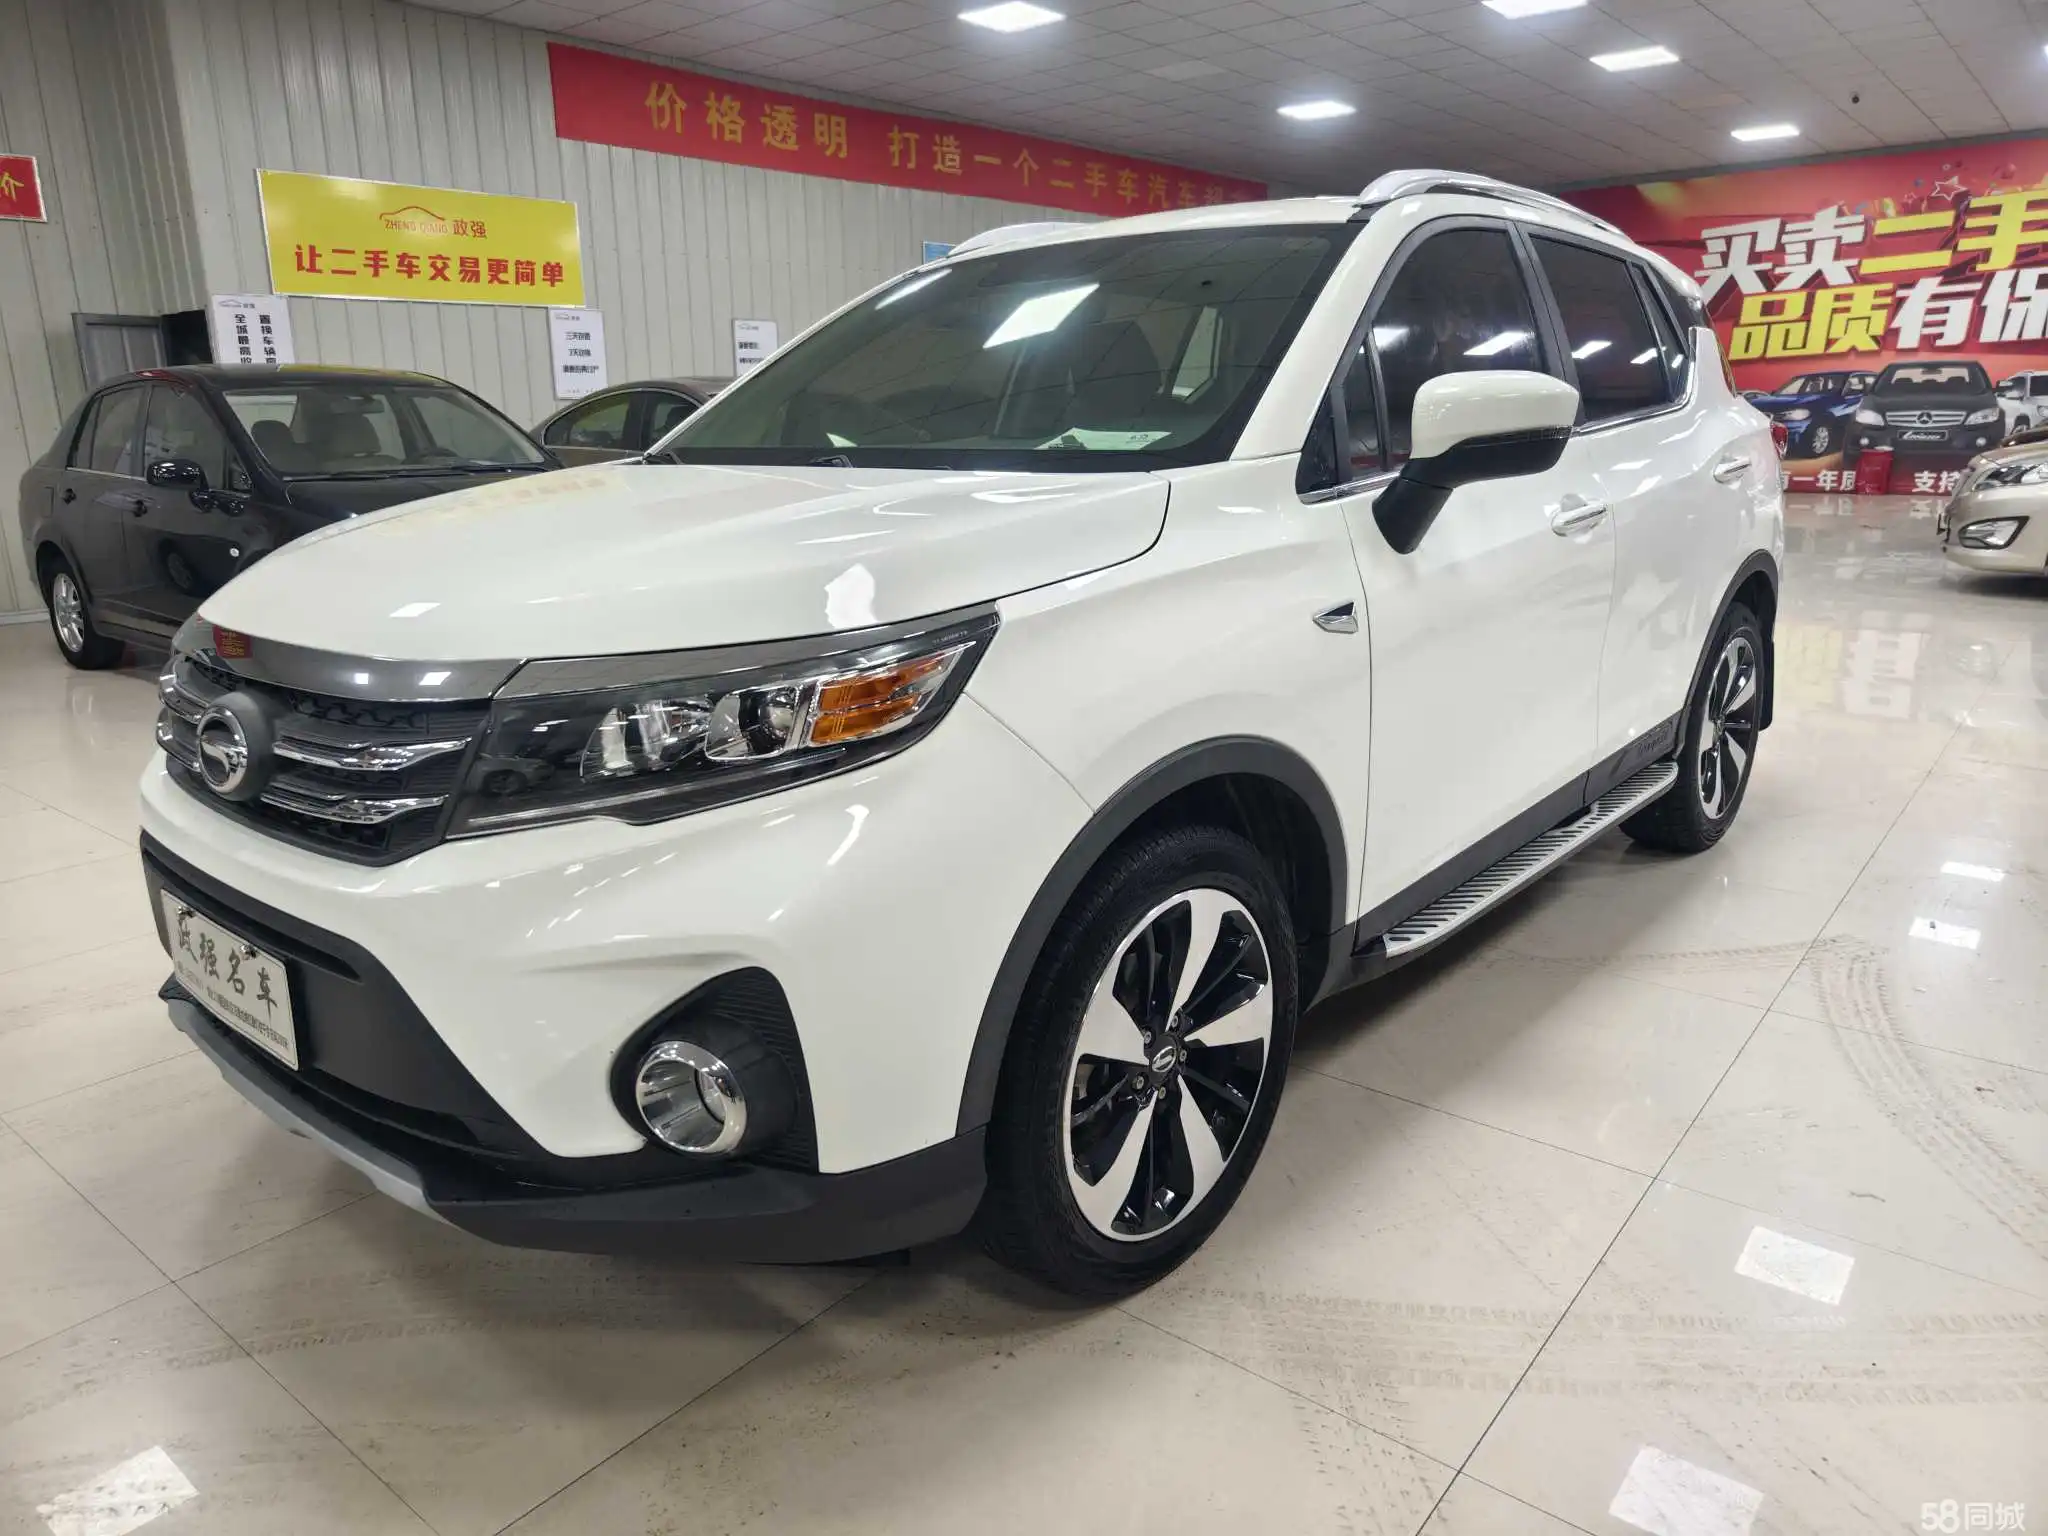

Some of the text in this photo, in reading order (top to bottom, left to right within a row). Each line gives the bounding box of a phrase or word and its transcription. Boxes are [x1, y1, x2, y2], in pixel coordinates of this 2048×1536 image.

[645, 81, 848, 159] 价格透明
[453, 218, 488, 238] 政强
[1694, 187, 2048, 305] 买卖二手
[295, 244, 564, 287] 让二手车交易更简单
[1729, 267, 2048, 361] 品质有保
[1911, 470, 1961, 493] 支持
